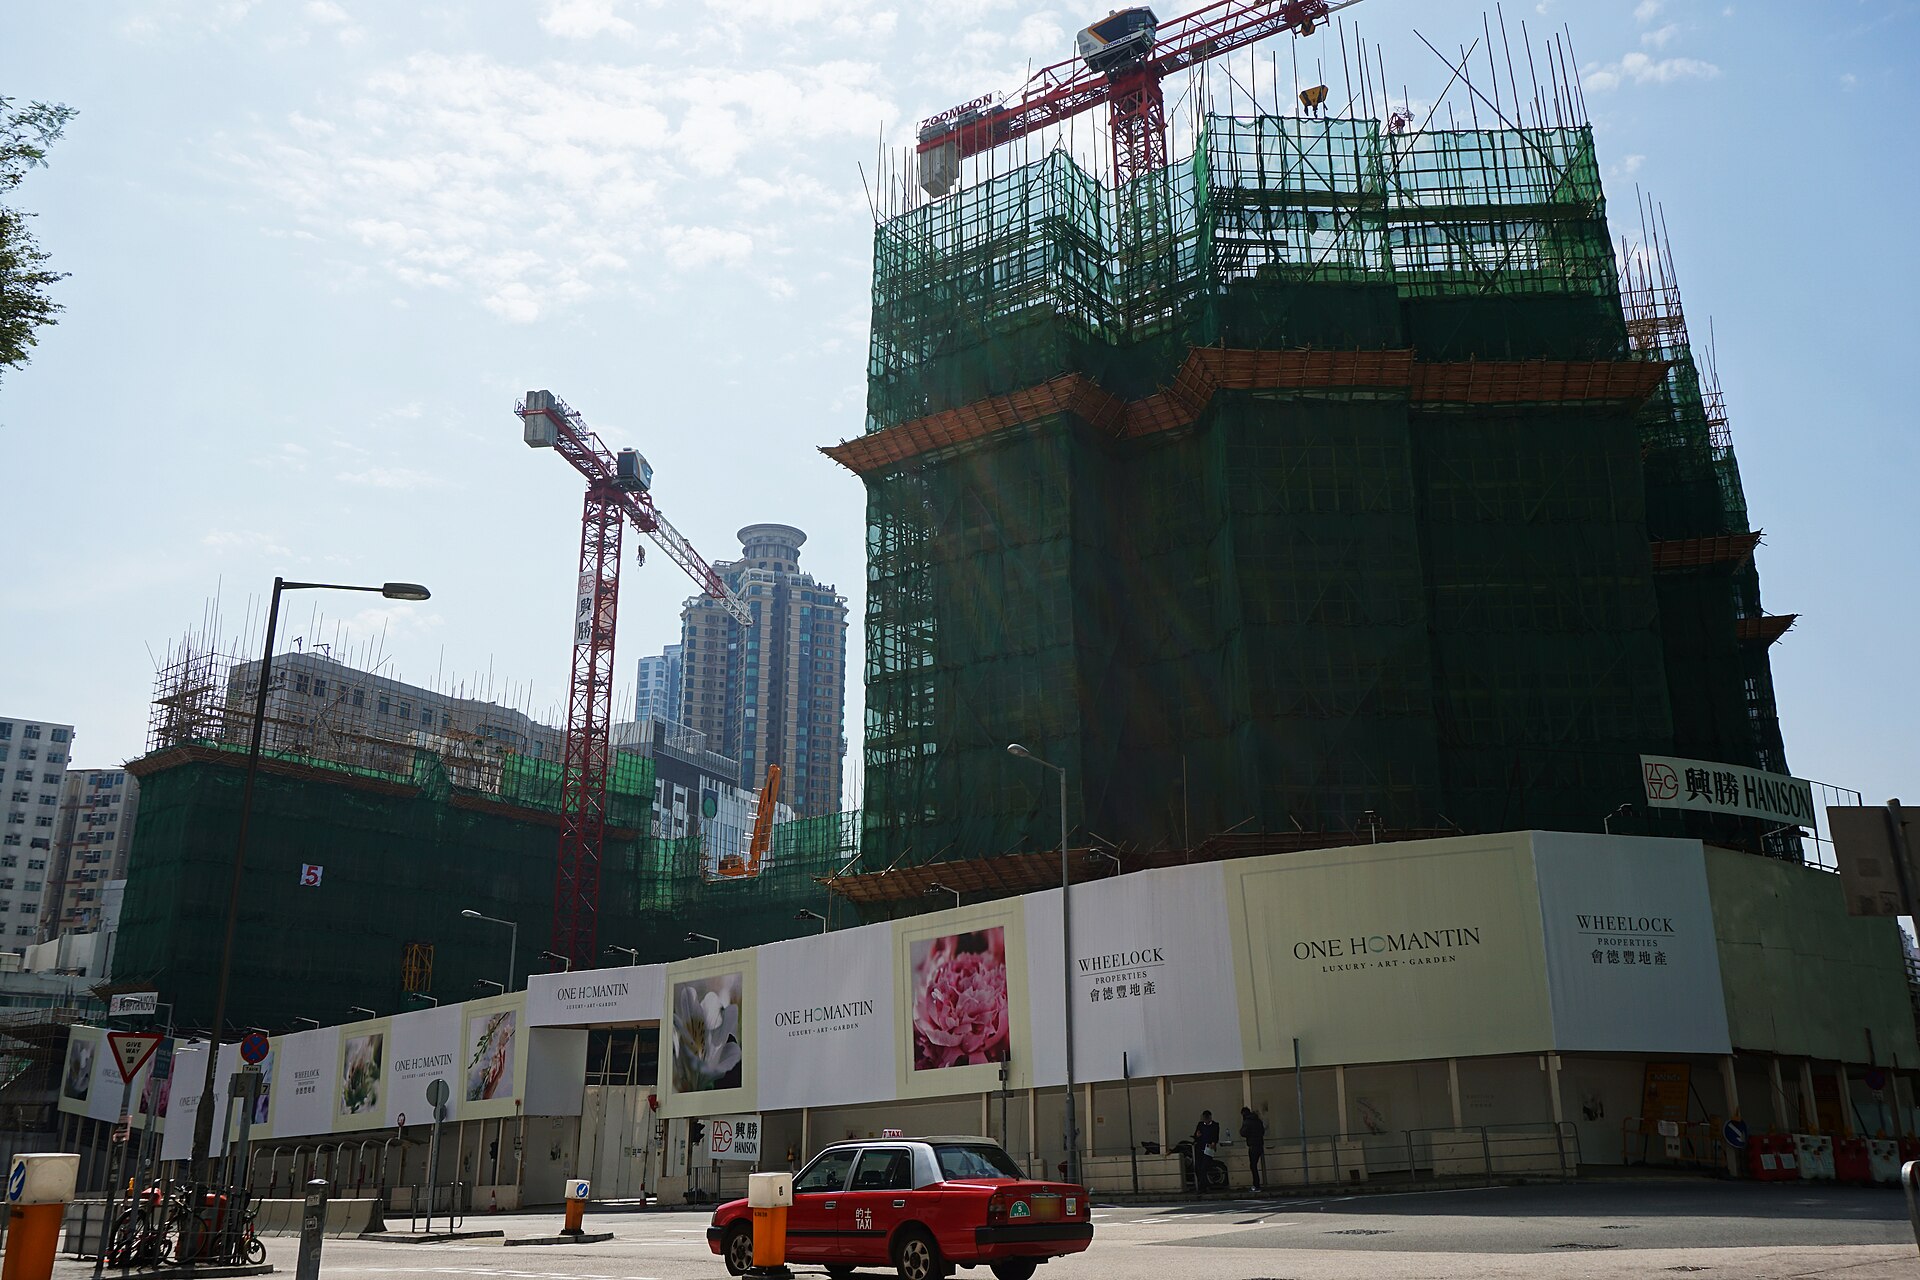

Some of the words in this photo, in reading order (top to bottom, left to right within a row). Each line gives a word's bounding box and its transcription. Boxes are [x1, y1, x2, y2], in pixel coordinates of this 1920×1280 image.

[922, 93, 992, 129] ZOOMLION
[1684, 767, 1740, 808] 興勝
[1743, 775, 1812, 821] HANISON
[305, 865, 318, 885] 5
[1576, 914, 1675, 933] WHEELOCK
[1293, 939, 1344, 960] ONE
[1350, 927, 1480, 955] HOMANTIN
[1597, 938, 1658, 947] PROPERTIES
[1079, 948, 1164, 972] WHEELOCK
[1322, 962, 1366, 973] LUXURY
[1377, 960, 1399, 968] ART
[1409, 955, 1457, 965] GARDEN
[1591, 949, 1667, 966] 會德豐地產
[1095, 971, 1148, 985] PROPERTIES
[557, 987, 576, 1000] ONE
[579, 983, 629, 999] HOMANTIN
[1090, 981, 1156, 1002] 會德豐地產
[775, 1010, 801, 1027] ONE
[804, 1000, 873, 1023] HOMANTIN
[788, 1029, 811, 1037] LUXURY
[816, 1026, 828, 1034] ART
[833, 1023, 859, 1031] GARDEN
[394, 1060, 411, 1072] ONE
[412, 1053, 453, 1069] HOMANTIN
[735, 1122, 758, 1140] 興勝
[887, 1130, 902, 1138] TAXI
[734, 1141, 757, 1154] HANISON
[855, 1208, 872, 1219] 的士
[855, 1219, 872, 1230] TAXI
